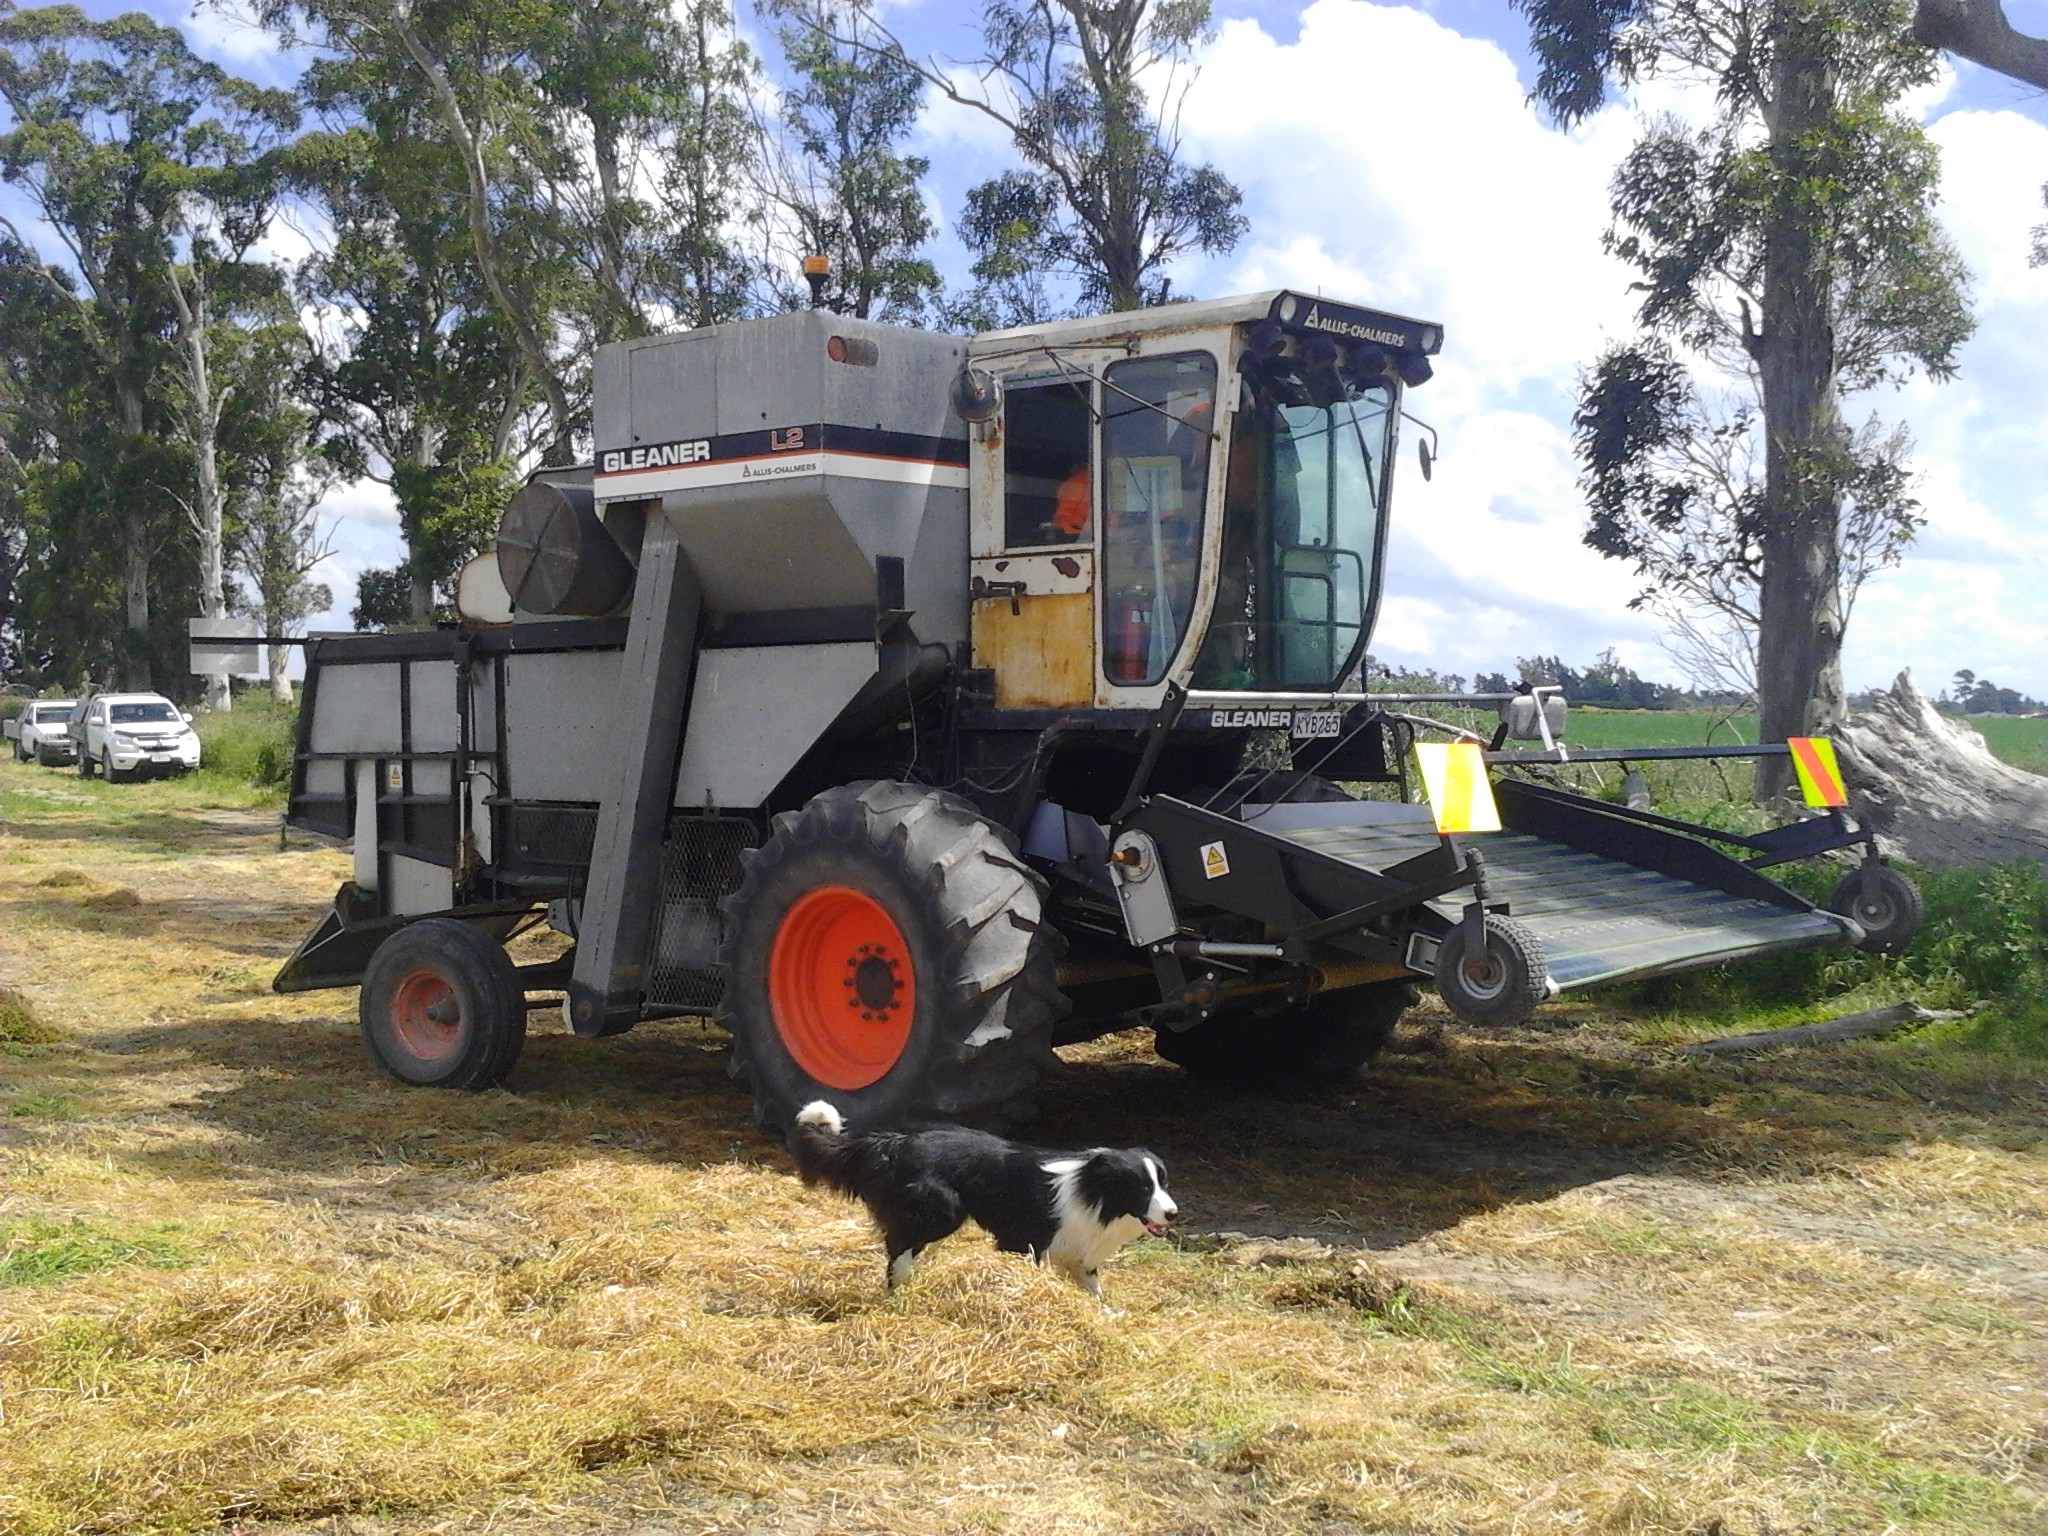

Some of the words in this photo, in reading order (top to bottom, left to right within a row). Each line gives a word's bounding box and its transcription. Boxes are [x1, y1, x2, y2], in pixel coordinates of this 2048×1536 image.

[1319, 317, 1405, 347] ALLIS-CHALMERS
[770, 427, 804, 451] L2
[603, 440, 711, 474] GLEANER
[752, 463, 817, 476] ALLIS-CHALMERS
[1211, 710, 1291, 728] GLEANER
